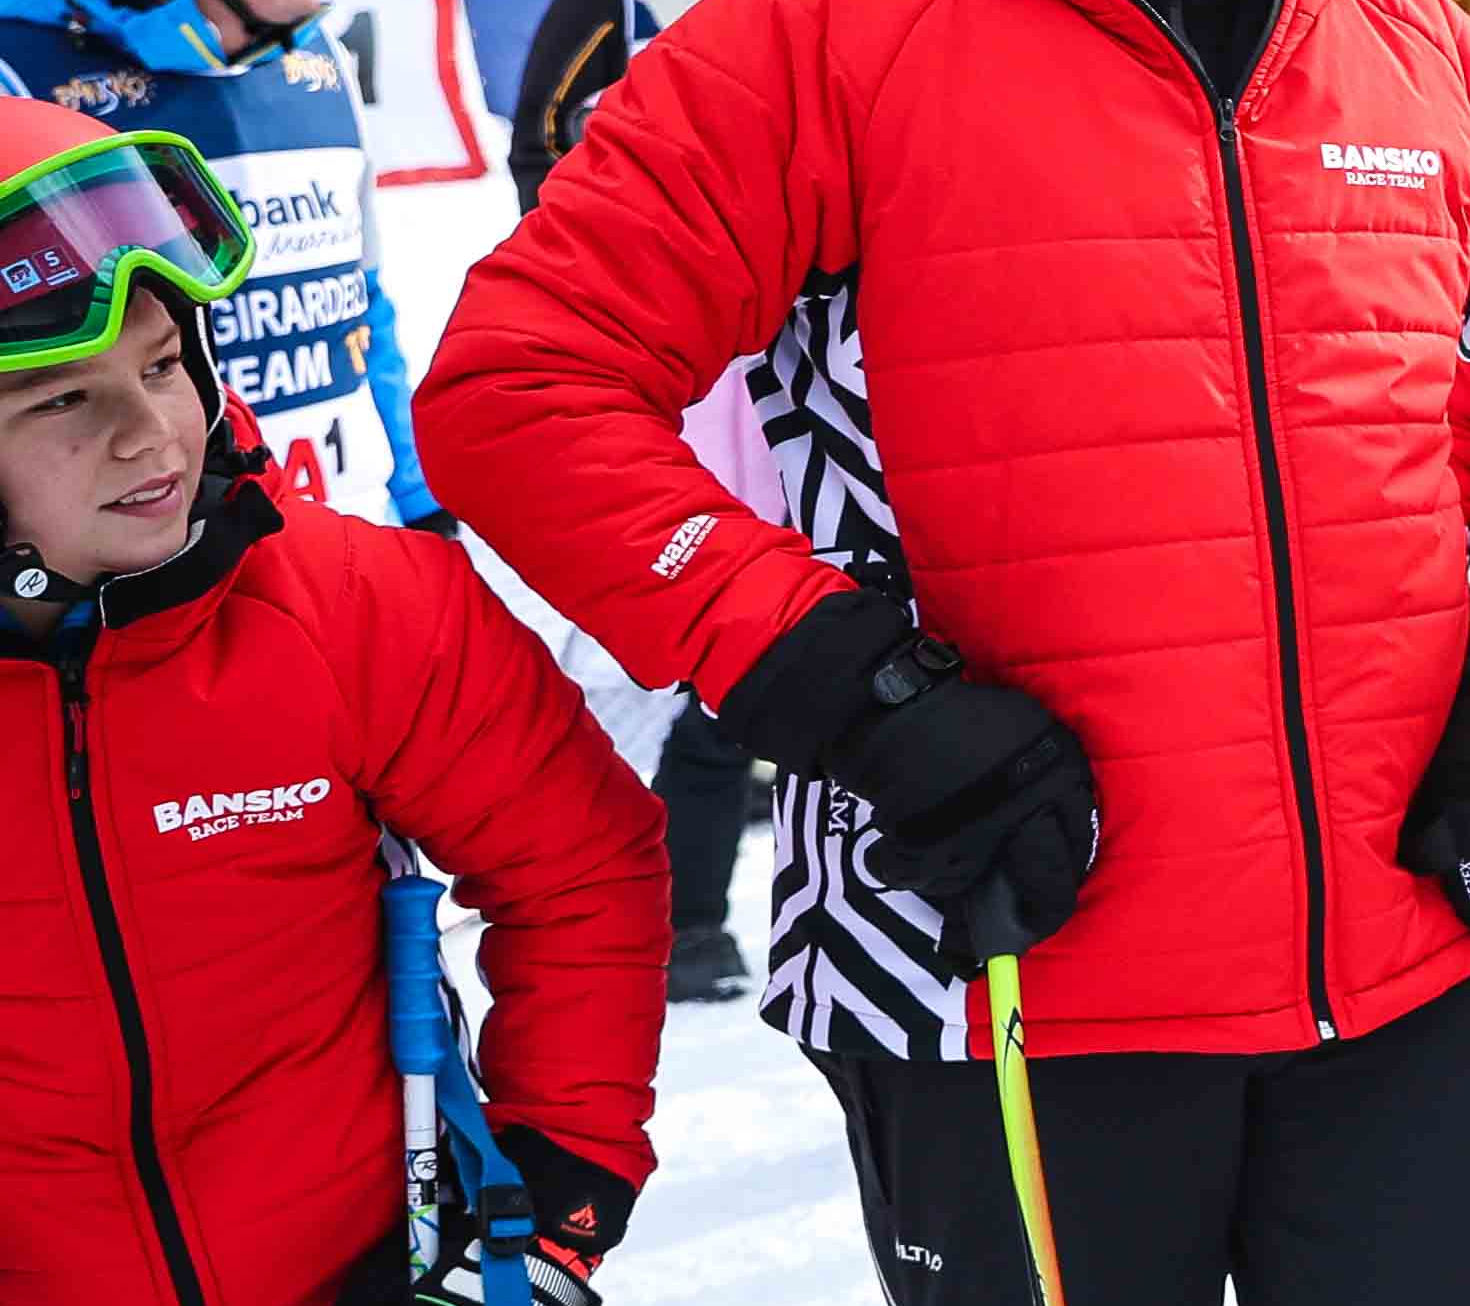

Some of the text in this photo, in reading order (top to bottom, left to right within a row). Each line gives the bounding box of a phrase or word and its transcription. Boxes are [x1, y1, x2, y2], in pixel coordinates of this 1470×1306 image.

[1321, 142, 1441, 177] BANSKO
[1345, 170, 1426, 191] RACE TEAM
[241, 181, 340, 231] bank
[152, 777, 331, 833] BANSKO
[188, 807, 304, 842] RACE TEAM
